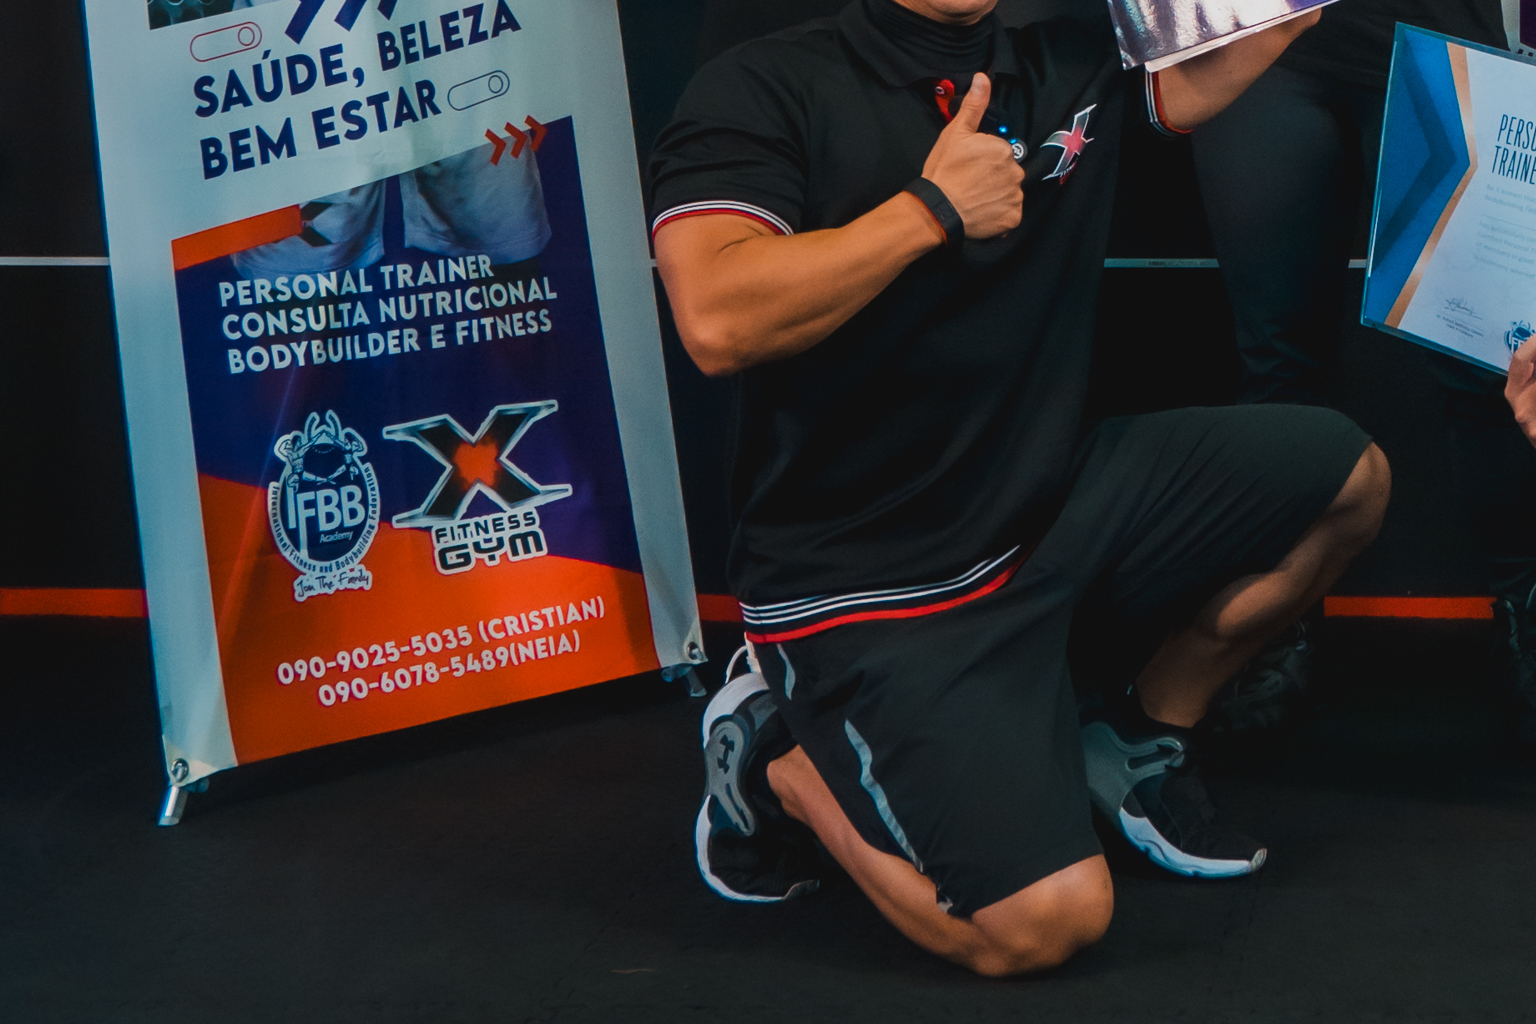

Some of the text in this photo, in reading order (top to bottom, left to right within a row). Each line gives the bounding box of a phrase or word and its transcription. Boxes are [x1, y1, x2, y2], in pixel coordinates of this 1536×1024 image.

[194, 43, 365, 118] SAÚDE,
[200, 79, 442, 180] BEM ESTAR
[218, 254, 494, 307] PERSONAL TRAINER
[222, 276, 557, 340] CONSULTA NUTRICIONAL
[228, 309, 552, 375] BODYBUILDER E FITNESS
[272, 467, 377, 573] International Fitness and Bodybuilding Federation
[285, 479, 366, 556] IFBB
[320, 531, 353, 543] Academy
[435, 511, 536, 544] FITNESS
[437, 530, 545, 571] GYM
[297, 579, 315, 597] Join
[315, 575, 335, 589] The
[277, 596, 605, 685] 090-9025-5035 (CRISTIAN)
